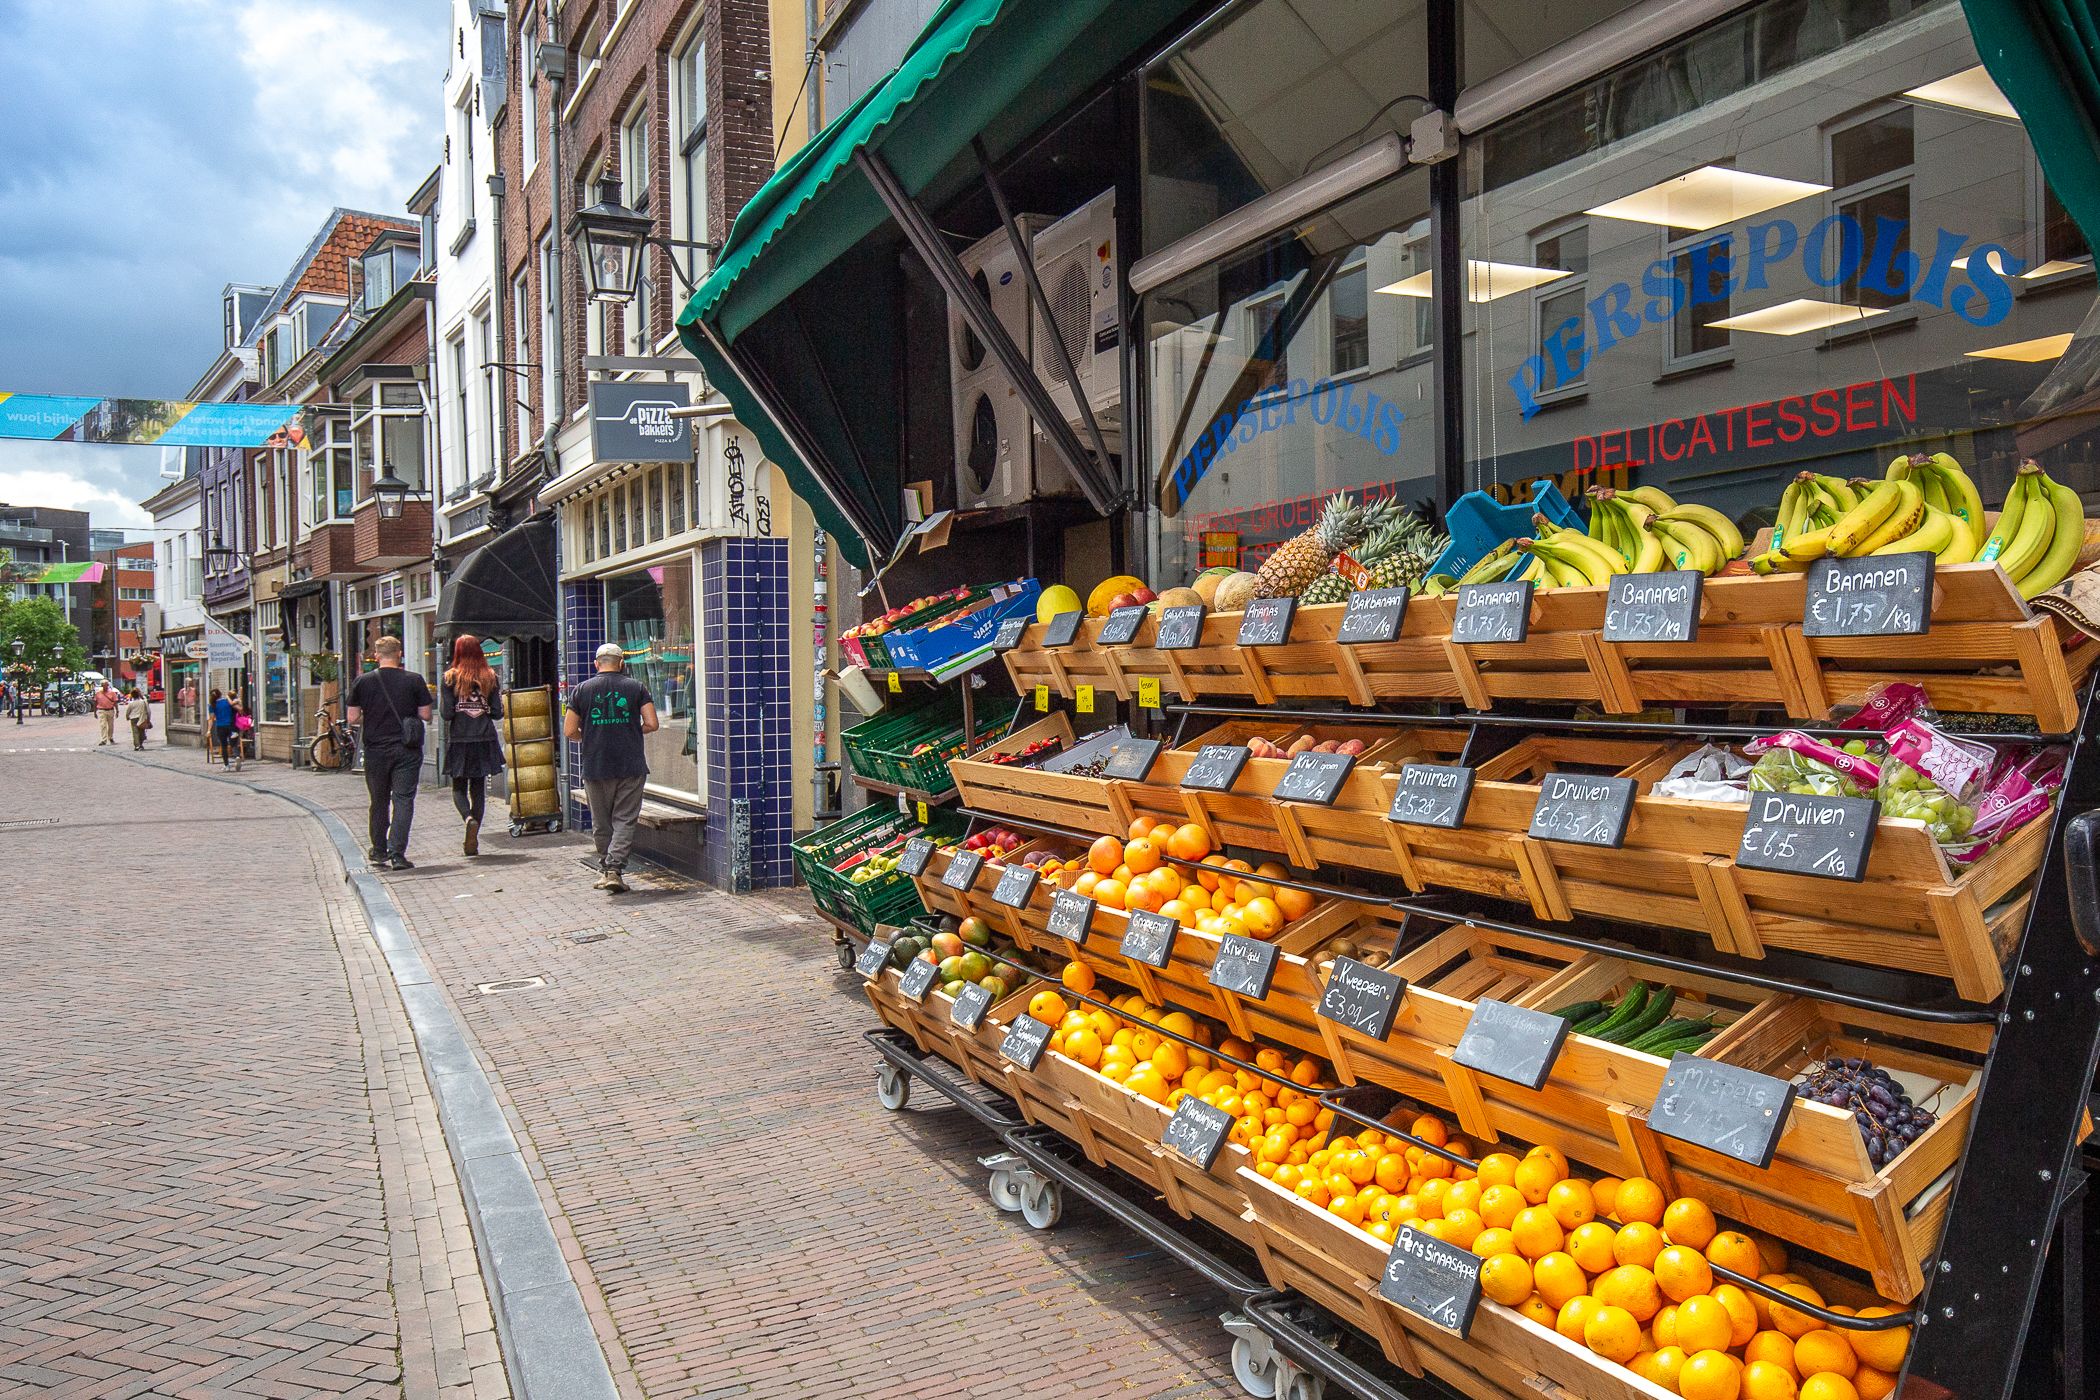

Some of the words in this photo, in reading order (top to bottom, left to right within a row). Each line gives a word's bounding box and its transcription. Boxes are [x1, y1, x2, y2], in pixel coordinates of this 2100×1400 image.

[1507, 215, 2027, 424] PERSEPOLIS
[1573, 373, 1917, 475] DELICATESSEN
[1173, 377, 1405, 506] PERSEPOLIS
[975, 619, 993, 639] JAZZ
[1552, 778, 1611, 801] Druiven
[1762, 797, 1845, 826] Druiven
[1396, 1227, 1424, 1258] Pers
[1388, 1259, 1406, 1282] €
